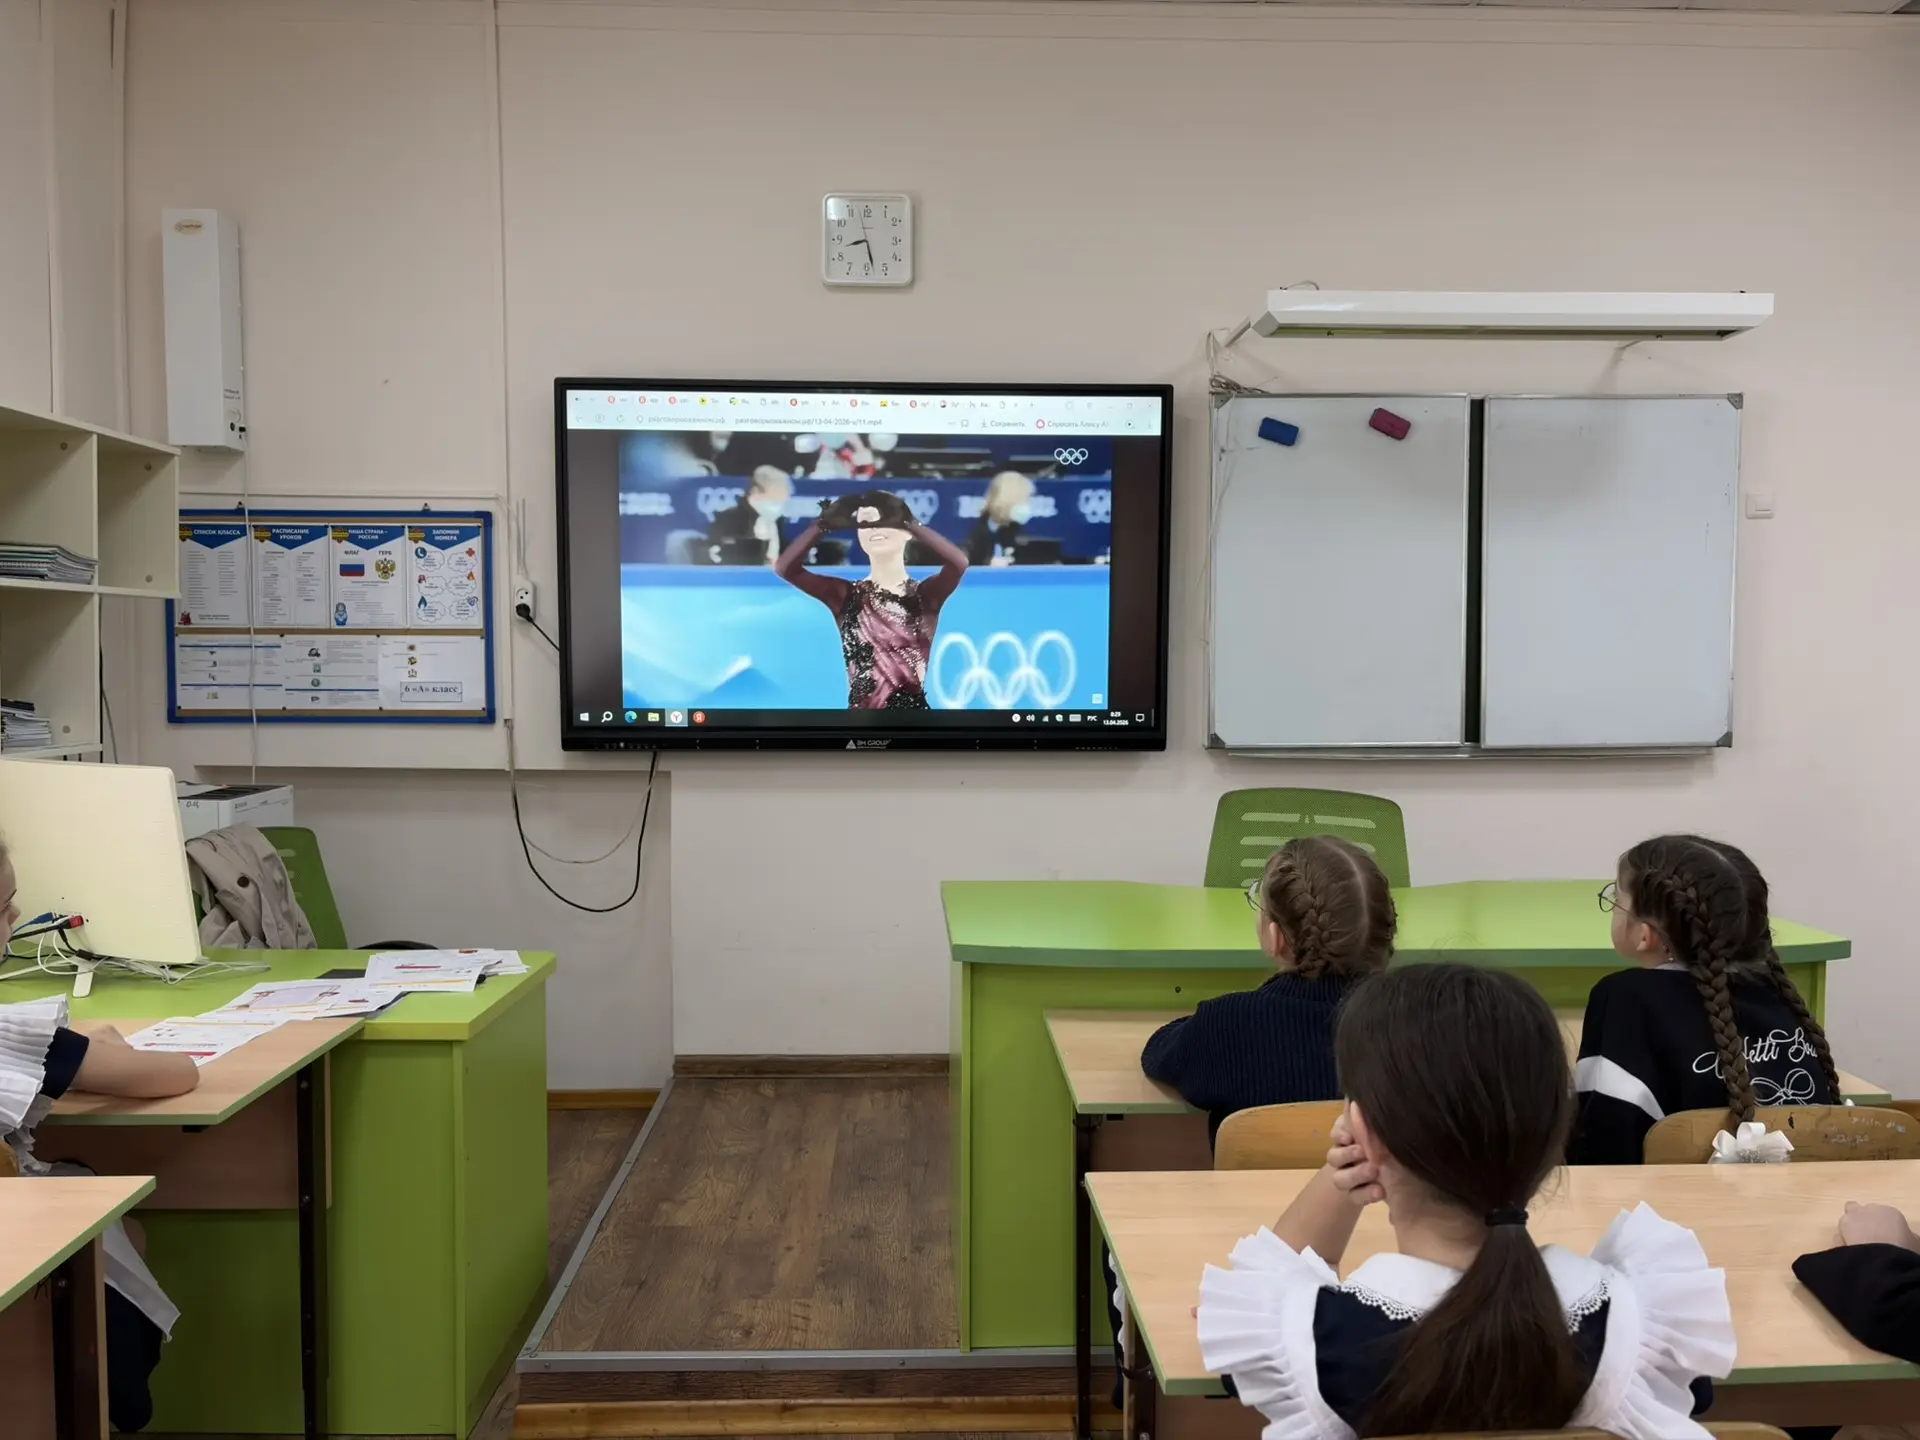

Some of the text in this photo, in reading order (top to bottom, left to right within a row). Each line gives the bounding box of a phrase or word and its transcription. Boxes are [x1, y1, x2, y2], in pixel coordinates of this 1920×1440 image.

[848, 208, 854, 218] 11
[863, 208, 872, 218] 12
[837, 218, 846, 228] 10
[891, 216, 898, 227] 2
[836, 234, 843, 245] 9
[892, 236, 898, 246] 3
[837, 252, 844, 261] 8
[892, 252, 898, 262] 4
[847, 261, 853, 272] 7
[864, 262, 870, 272] 6
[882, 262, 888, 273] 5
[344, 549, 360, 557] ФЛАГ
[404, 685, 410, 693] 6
